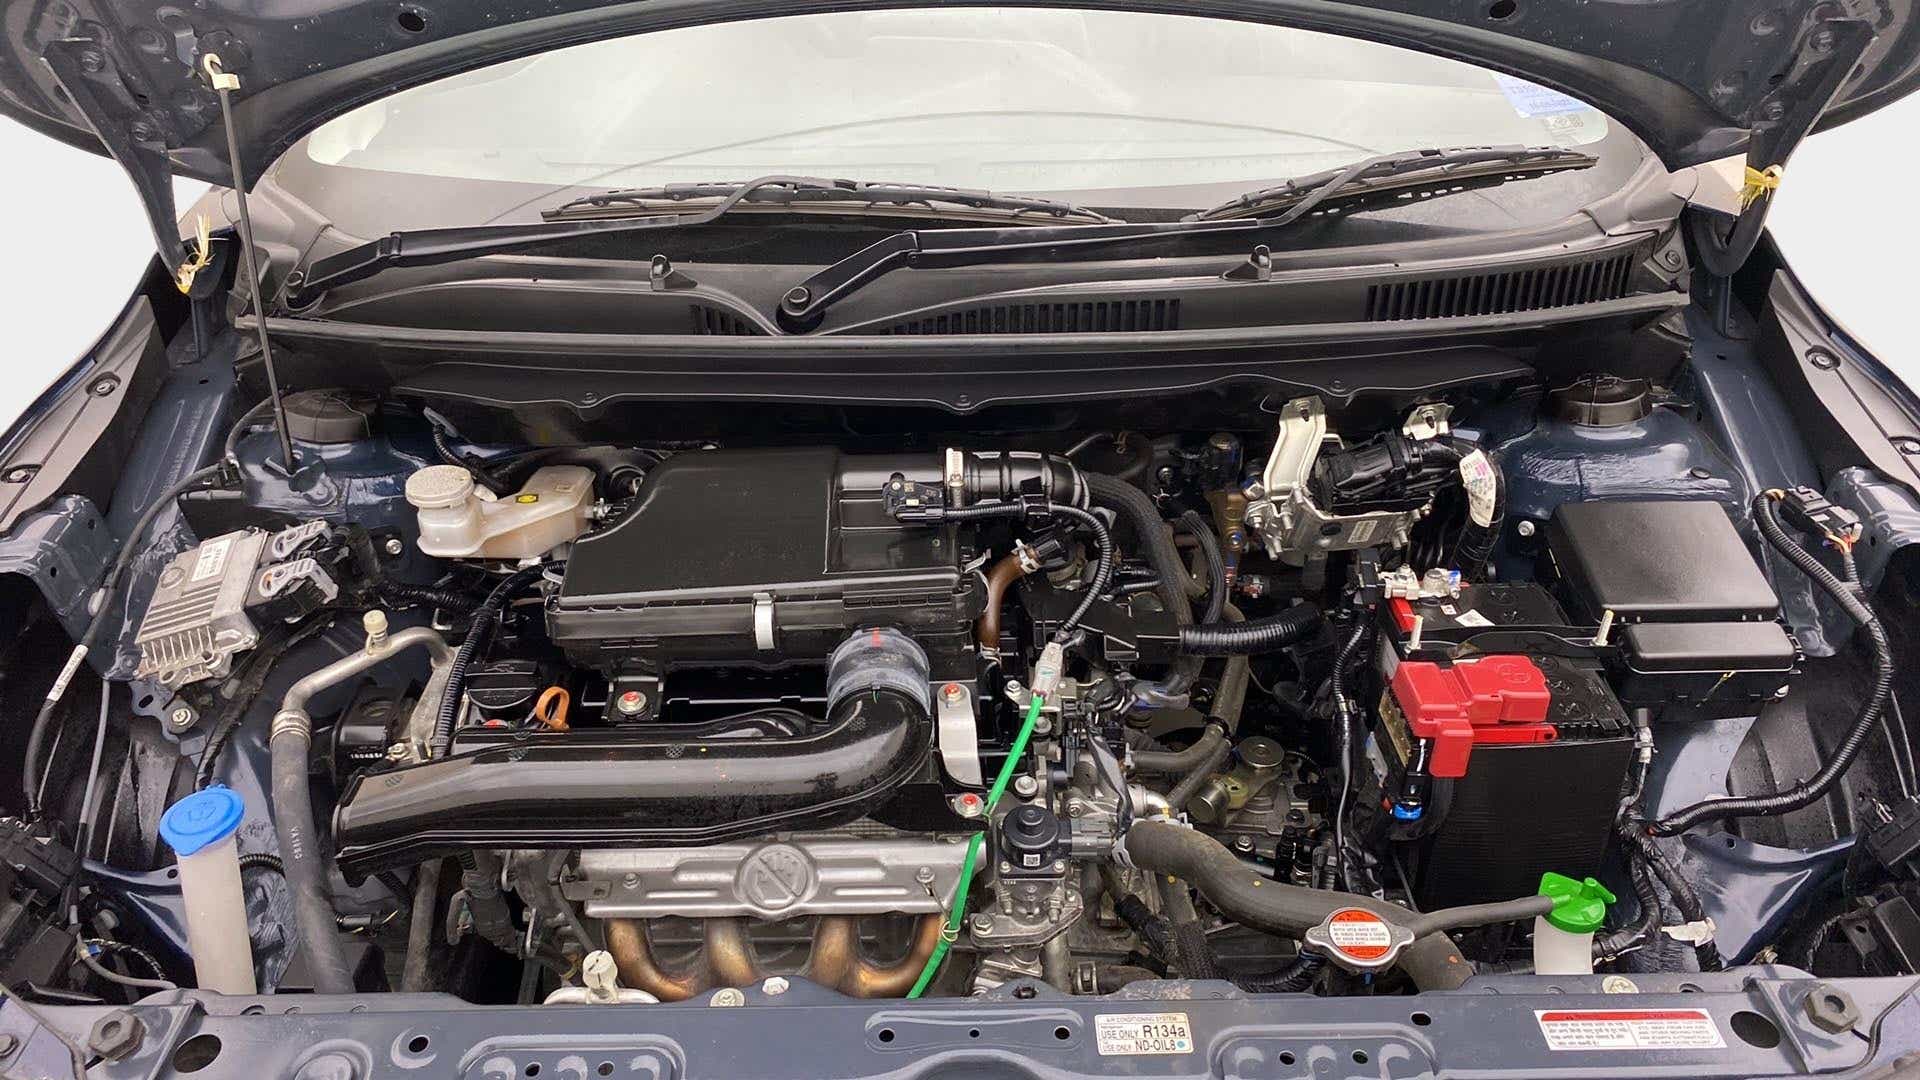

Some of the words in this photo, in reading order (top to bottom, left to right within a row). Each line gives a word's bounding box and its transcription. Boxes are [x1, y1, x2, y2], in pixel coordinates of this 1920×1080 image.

[1101, 1031, 1116, 1039] USE
[1119, 1030, 1139, 1039] ONLY
[1142, 1024, 1186, 1038] R134a
[1135, 1039, 1176, 1051] ND-OIL8
